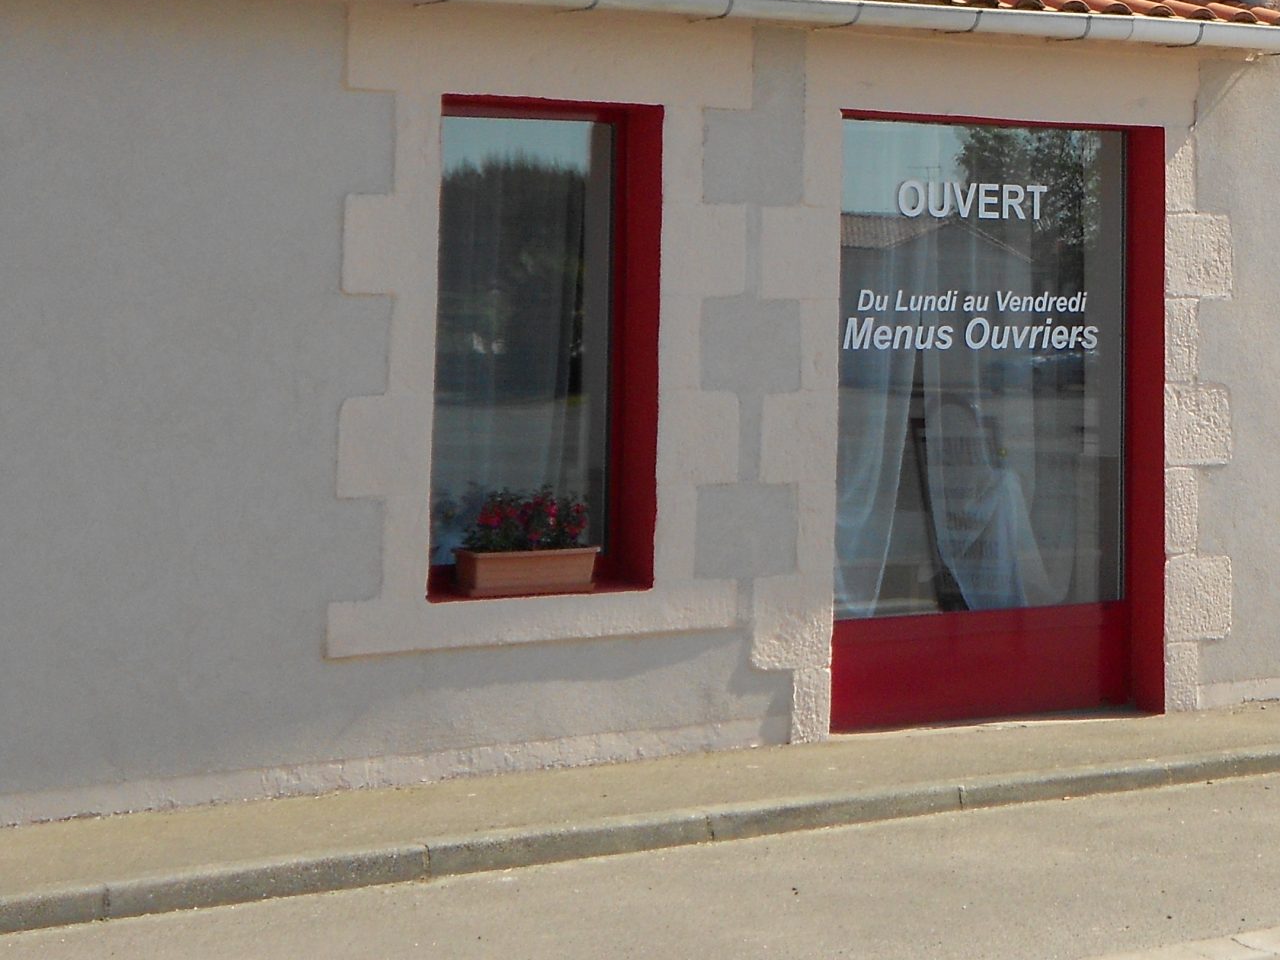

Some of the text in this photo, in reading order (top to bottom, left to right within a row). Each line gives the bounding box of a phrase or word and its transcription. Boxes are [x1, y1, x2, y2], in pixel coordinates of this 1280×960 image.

[898, 179, 1048, 220] OUVERT
[857, 289, 1087, 313] Du Lundi au Vendredi
[842, 316, 1098, 350] Menus Ouvriers
